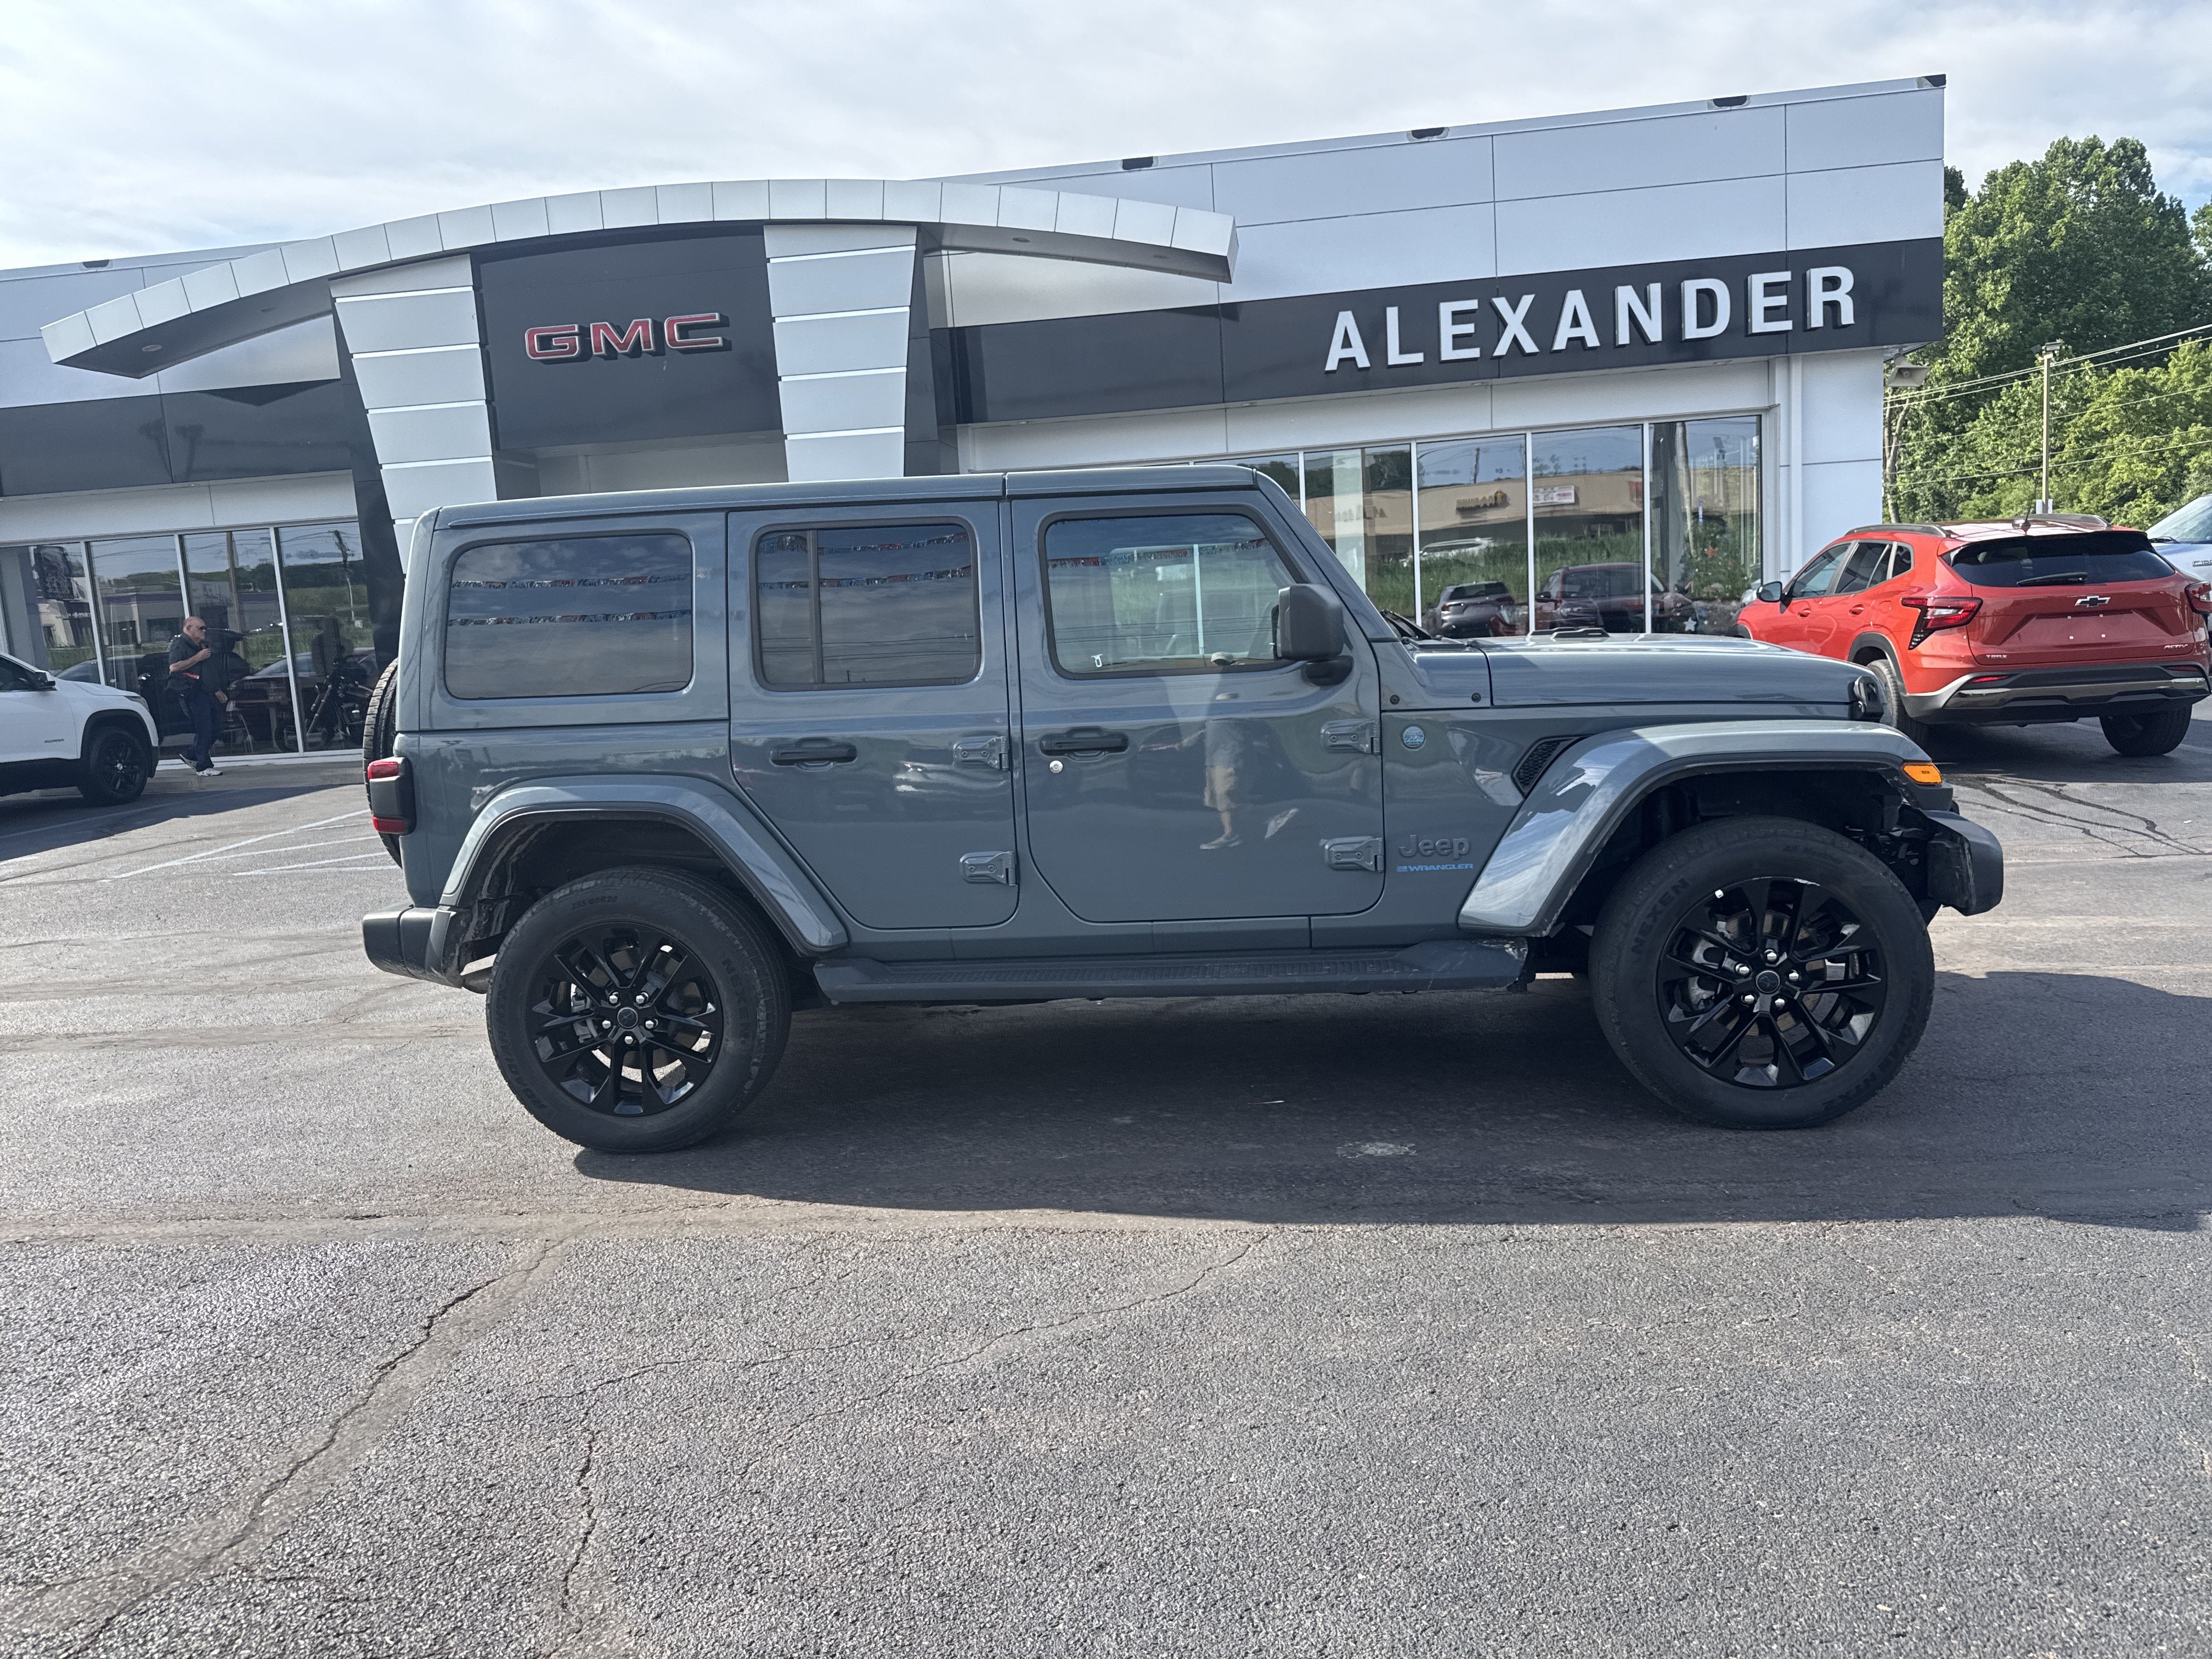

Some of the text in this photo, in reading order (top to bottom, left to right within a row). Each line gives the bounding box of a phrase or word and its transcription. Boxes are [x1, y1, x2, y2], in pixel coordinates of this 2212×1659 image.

[525, 312, 724, 360] GMC
[1324, 266, 1856, 373] ALEXANDER
[1399, 834, 1470, 860] Jeep
[1408, 863, 1474, 872] WRANGLER
[1631, 878, 1690, 955] NEXEN
[721, 958, 751, 1040] NEXEN
